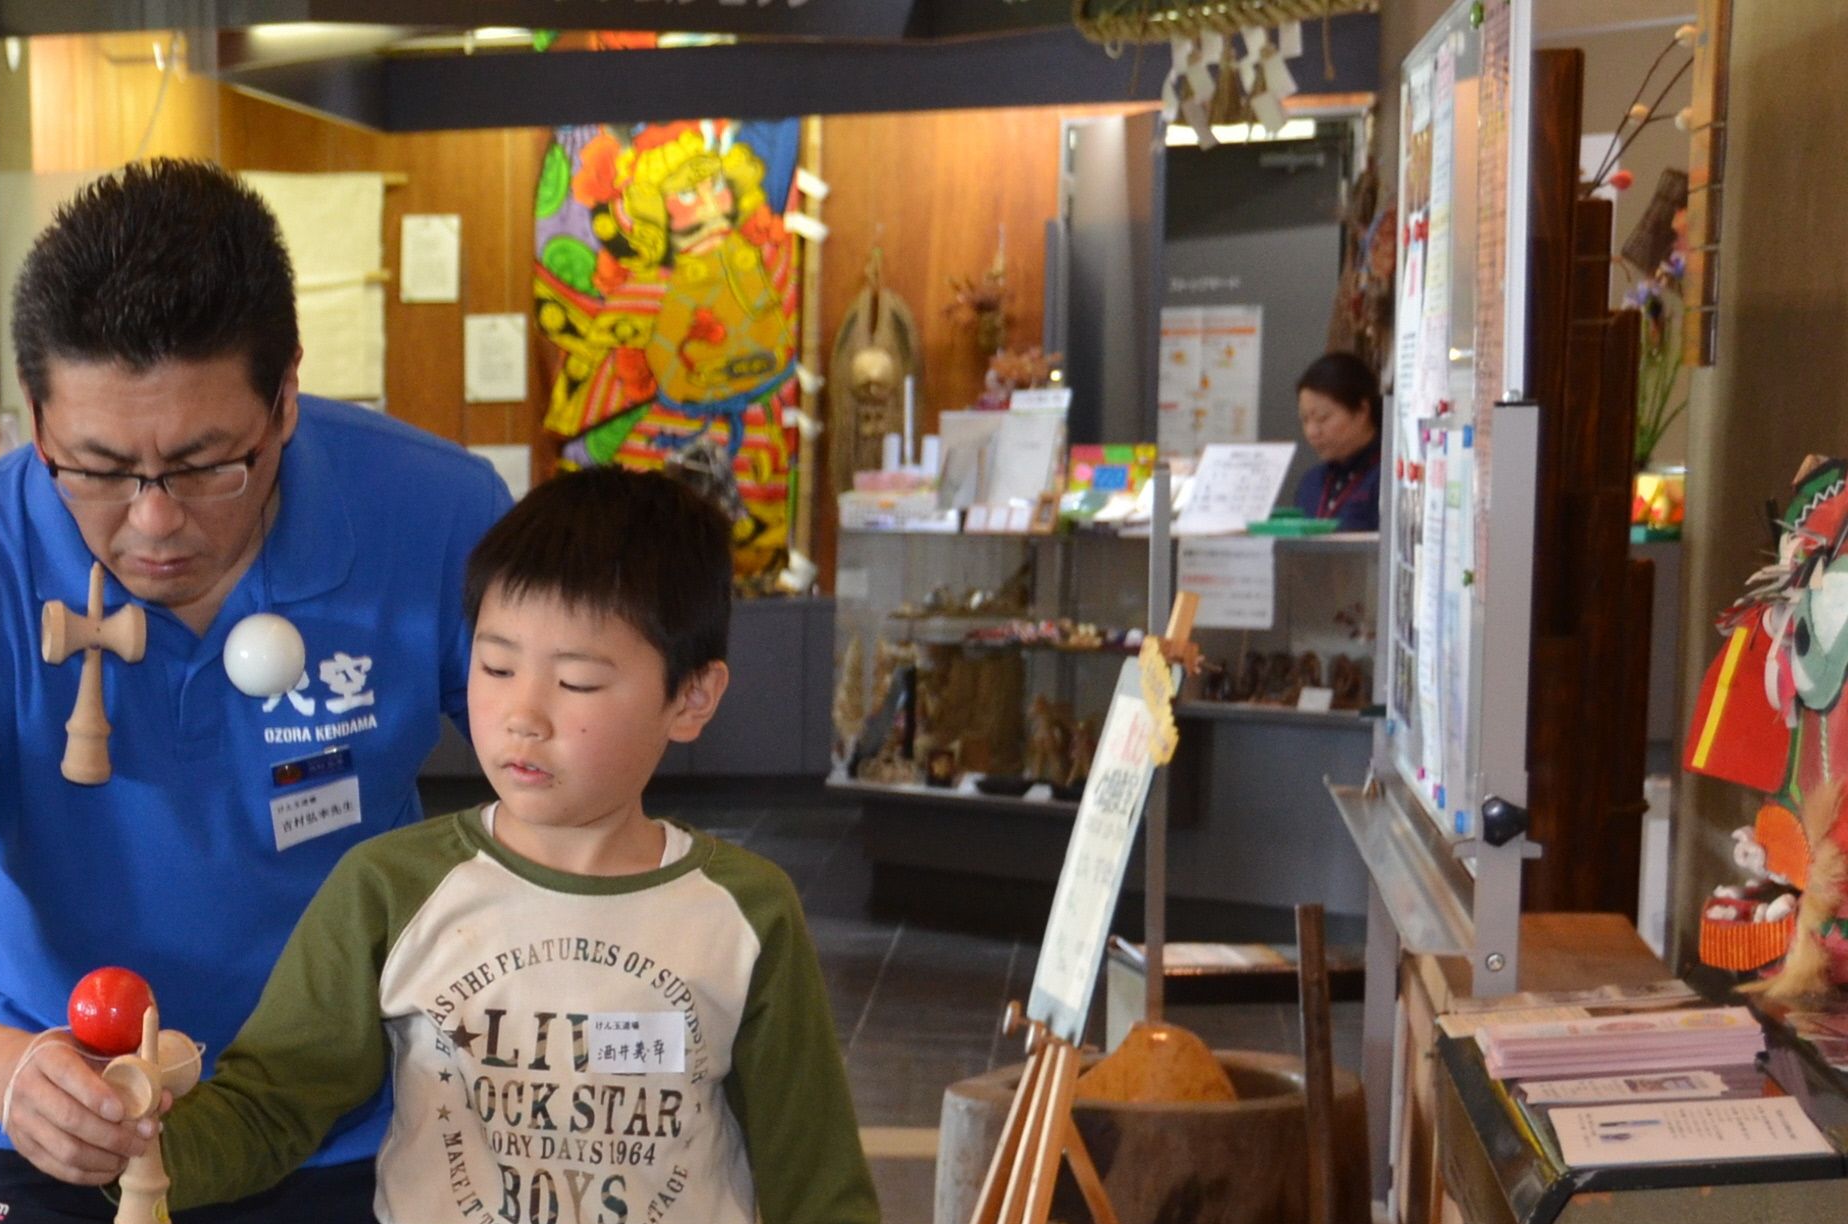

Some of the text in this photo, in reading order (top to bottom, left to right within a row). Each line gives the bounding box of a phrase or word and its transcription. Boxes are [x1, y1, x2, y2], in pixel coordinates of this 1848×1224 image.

[264, 713, 378, 743] OZORA KENDAMA
[449, 962, 496, 1002] THE
[494, 937, 620, 977] FEATURES
[622, 950, 655, 979] OF
[480, 1008, 646, 1077] LIV
[458, 1066, 684, 1139] OCK STAR
[442, 1130, 471, 1193] MAKE
[540, 1135, 604, 1166] DAYS
[608, 1140, 656, 1167] 1964
[456, 1191, 484, 1218] IT
